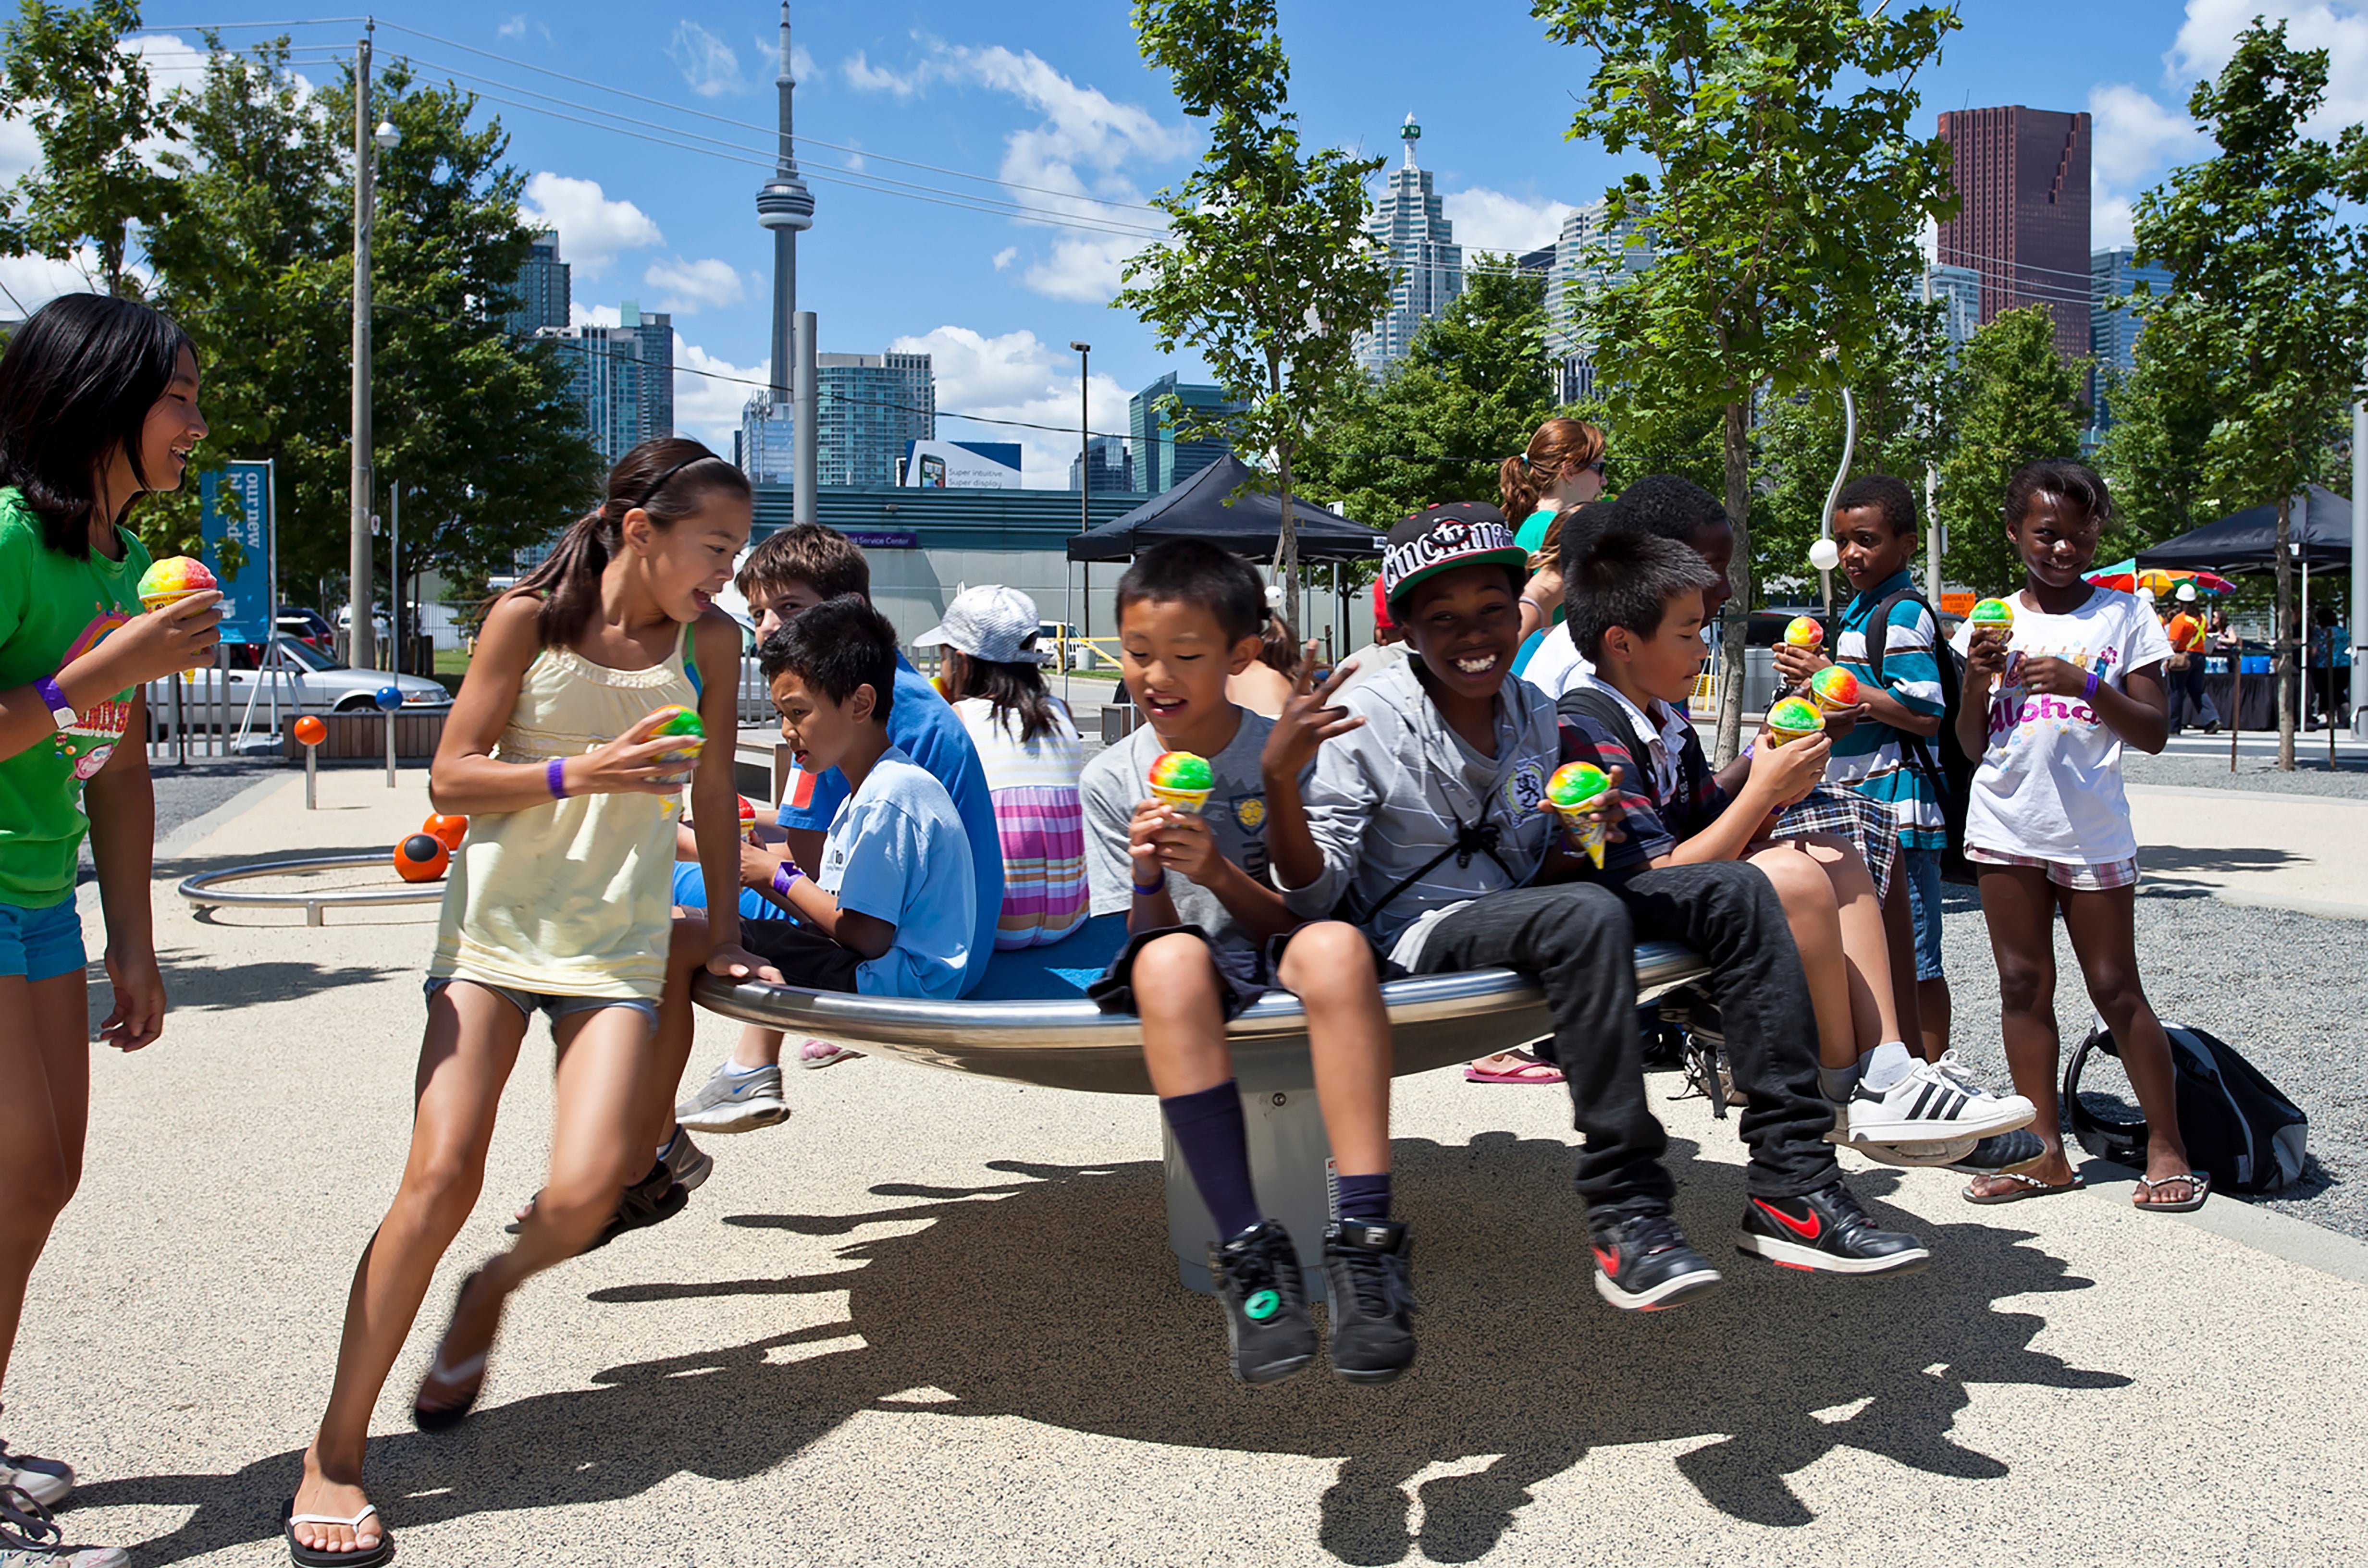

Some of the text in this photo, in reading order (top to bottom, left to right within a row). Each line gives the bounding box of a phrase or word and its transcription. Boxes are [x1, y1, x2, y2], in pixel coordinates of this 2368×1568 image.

[949, 468, 971, 477] Super
[948, 478, 971, 487] Super
[246, 472, 260, 549] our new
[859, 536, 885, 544] Service
[886, 536, 909, 544] Center
